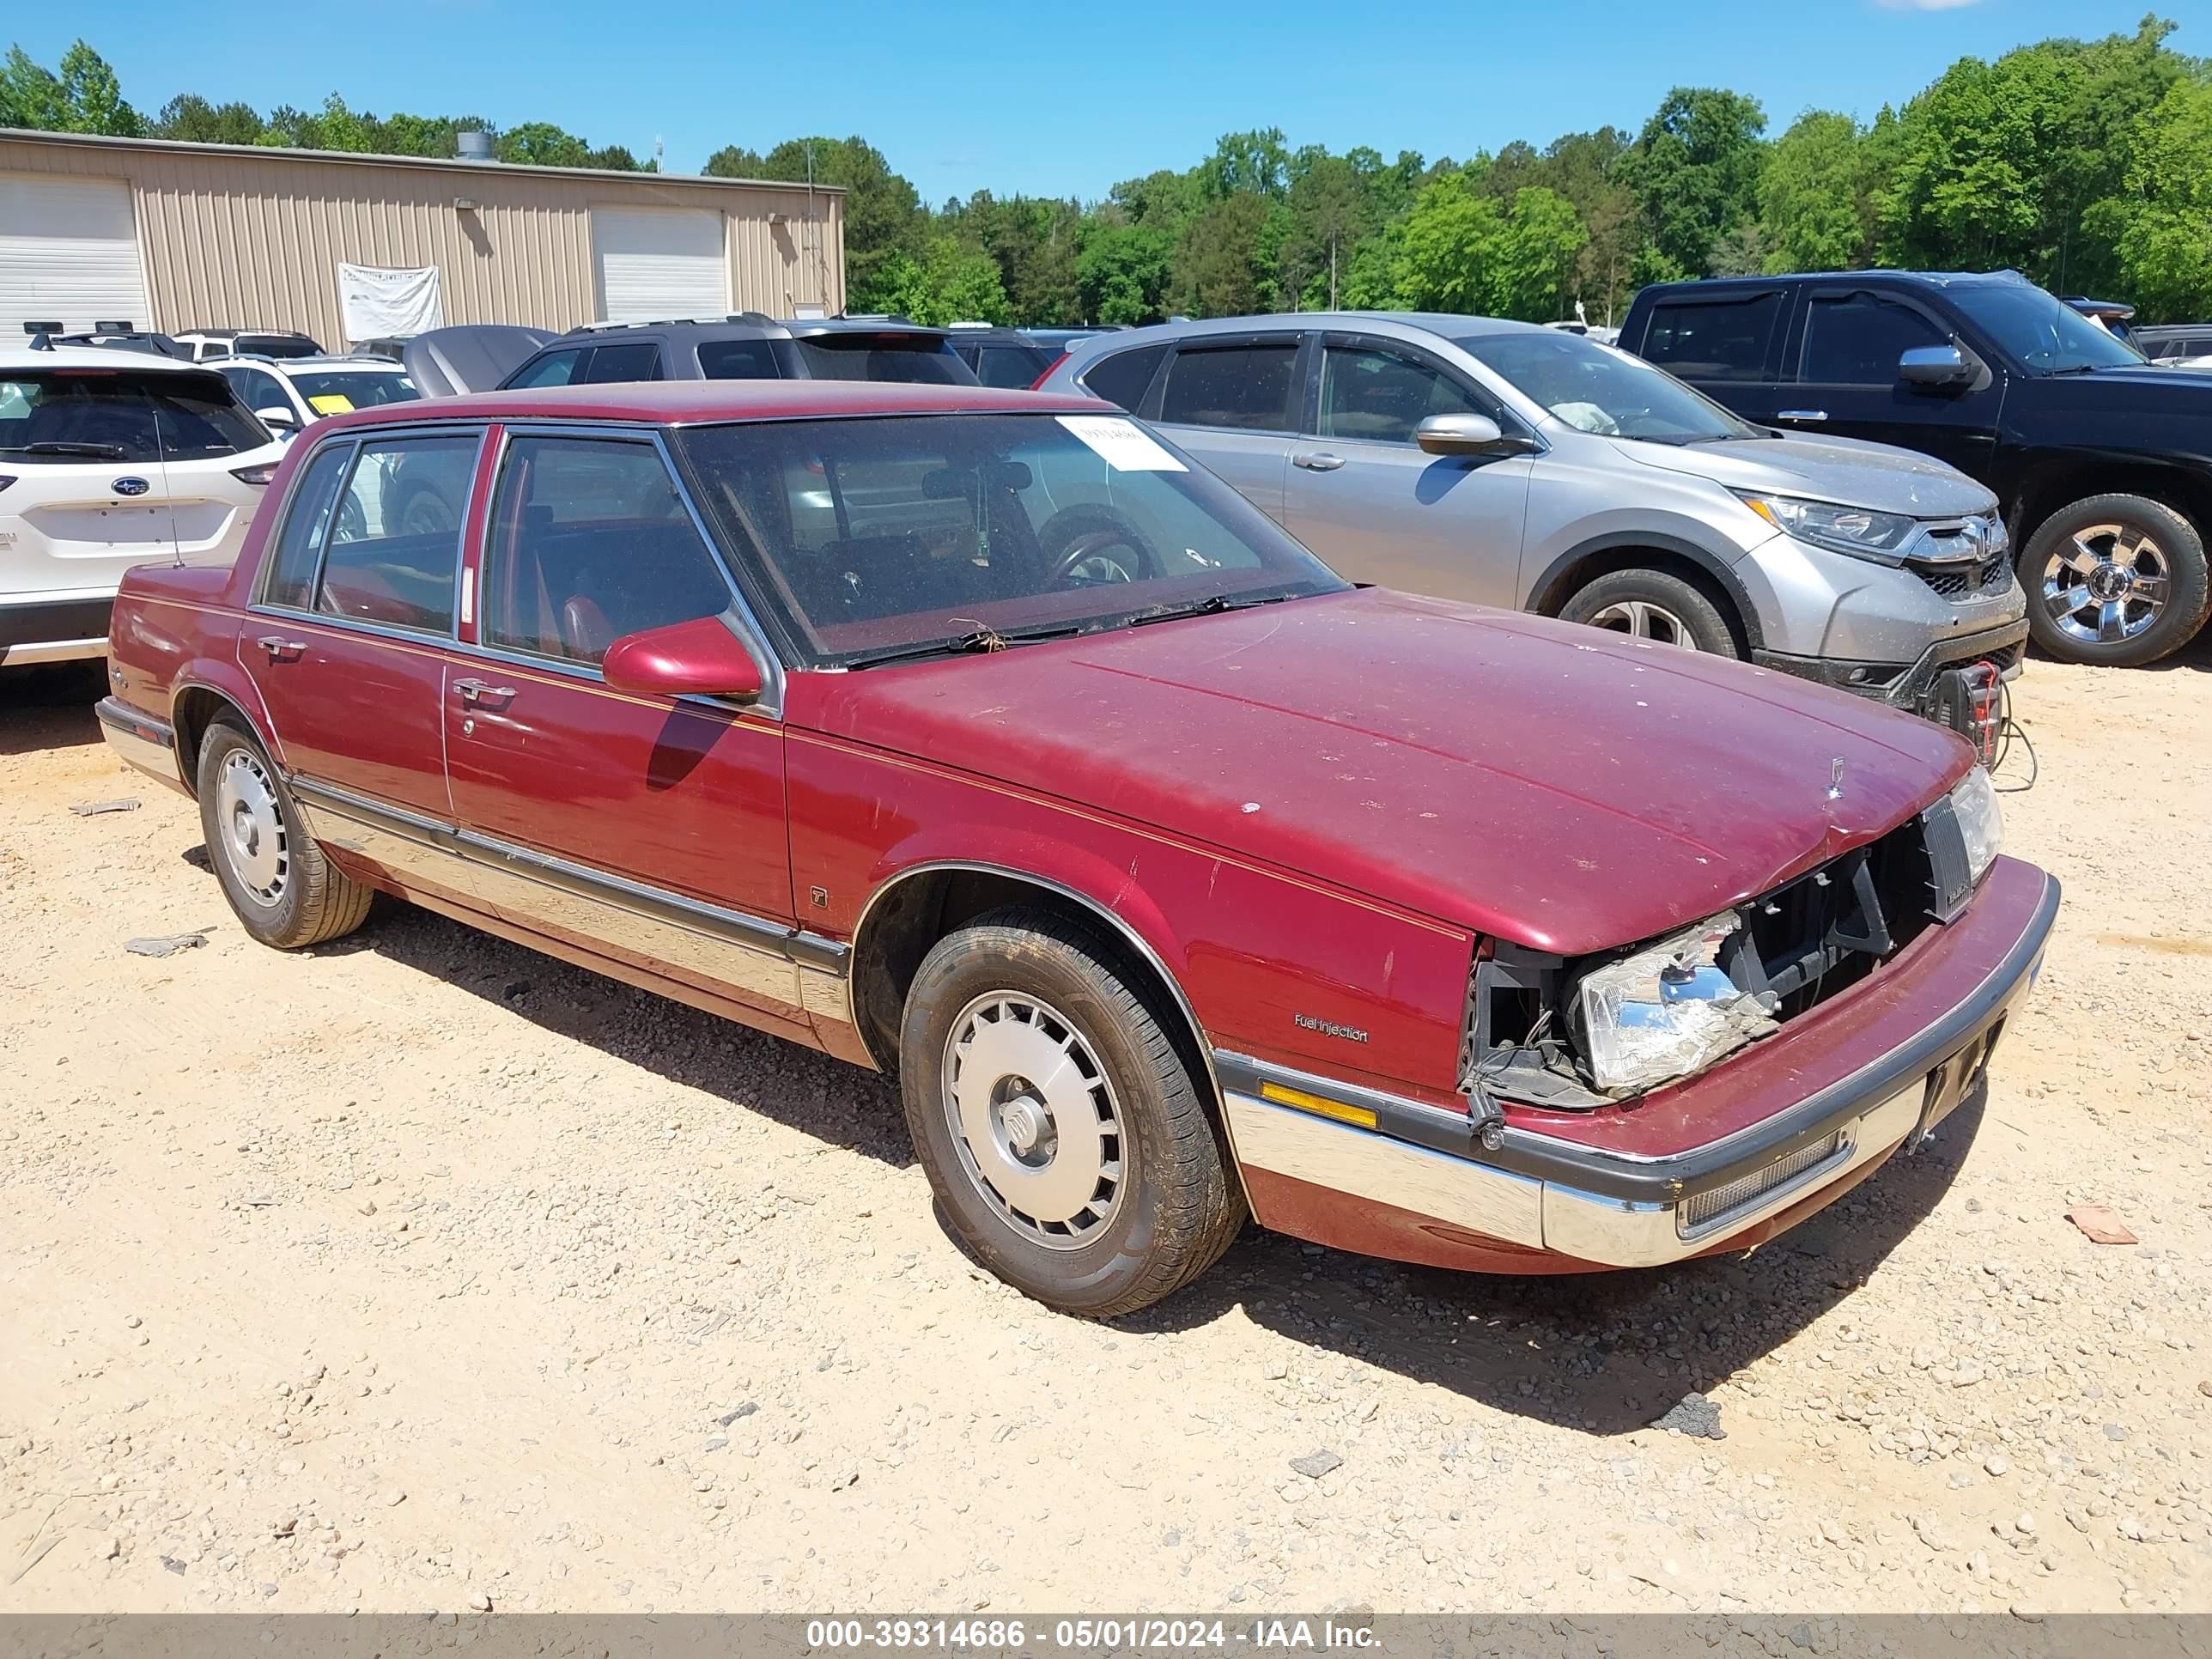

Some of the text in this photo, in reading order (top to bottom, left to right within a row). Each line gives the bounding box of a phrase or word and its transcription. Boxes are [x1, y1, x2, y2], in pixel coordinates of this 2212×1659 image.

[812, 890, 823, 902] T
[1294, 1014, 1368, 1042] Fuel Injection
